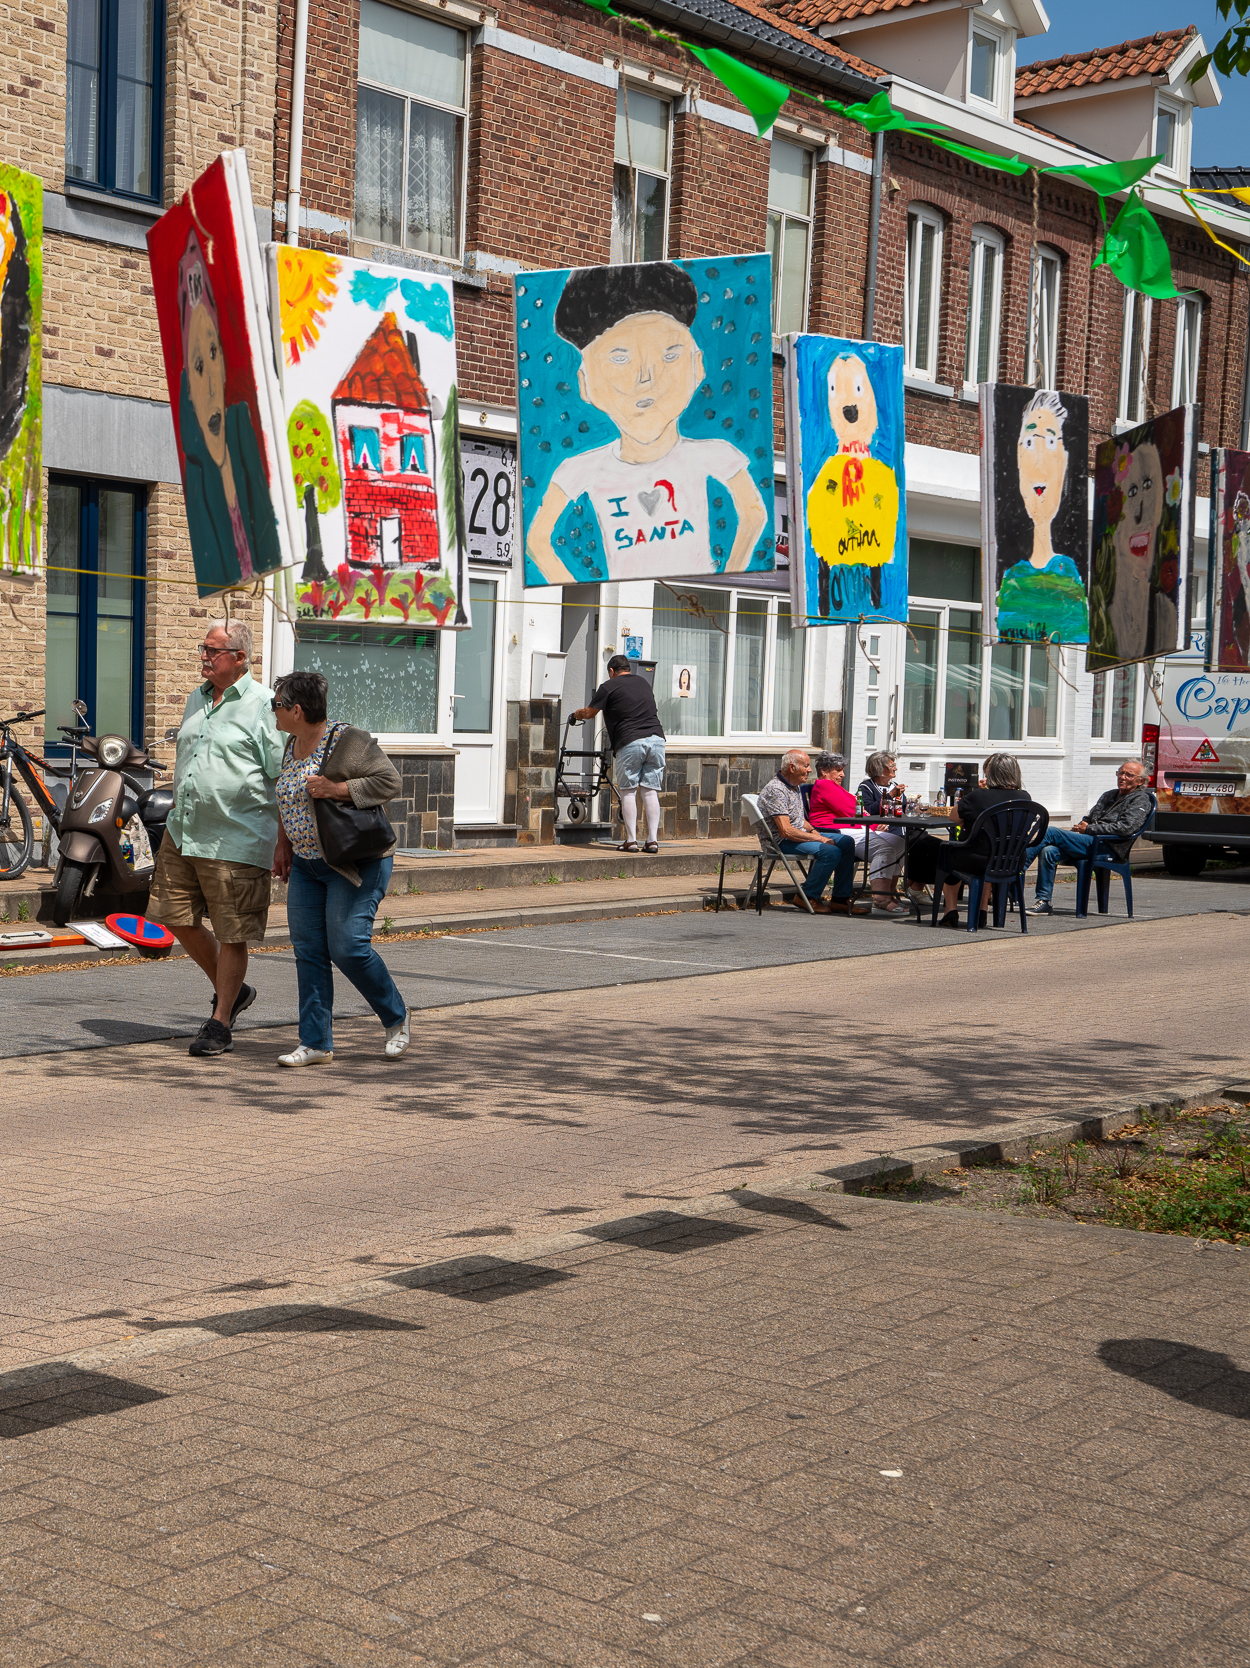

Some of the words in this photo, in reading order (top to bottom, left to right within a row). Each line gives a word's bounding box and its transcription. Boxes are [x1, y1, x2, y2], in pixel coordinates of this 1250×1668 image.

[607, 496, 629, 517] I
[614, 518, 694, 550] SANTA
[496, 541, 510, 558] 59
